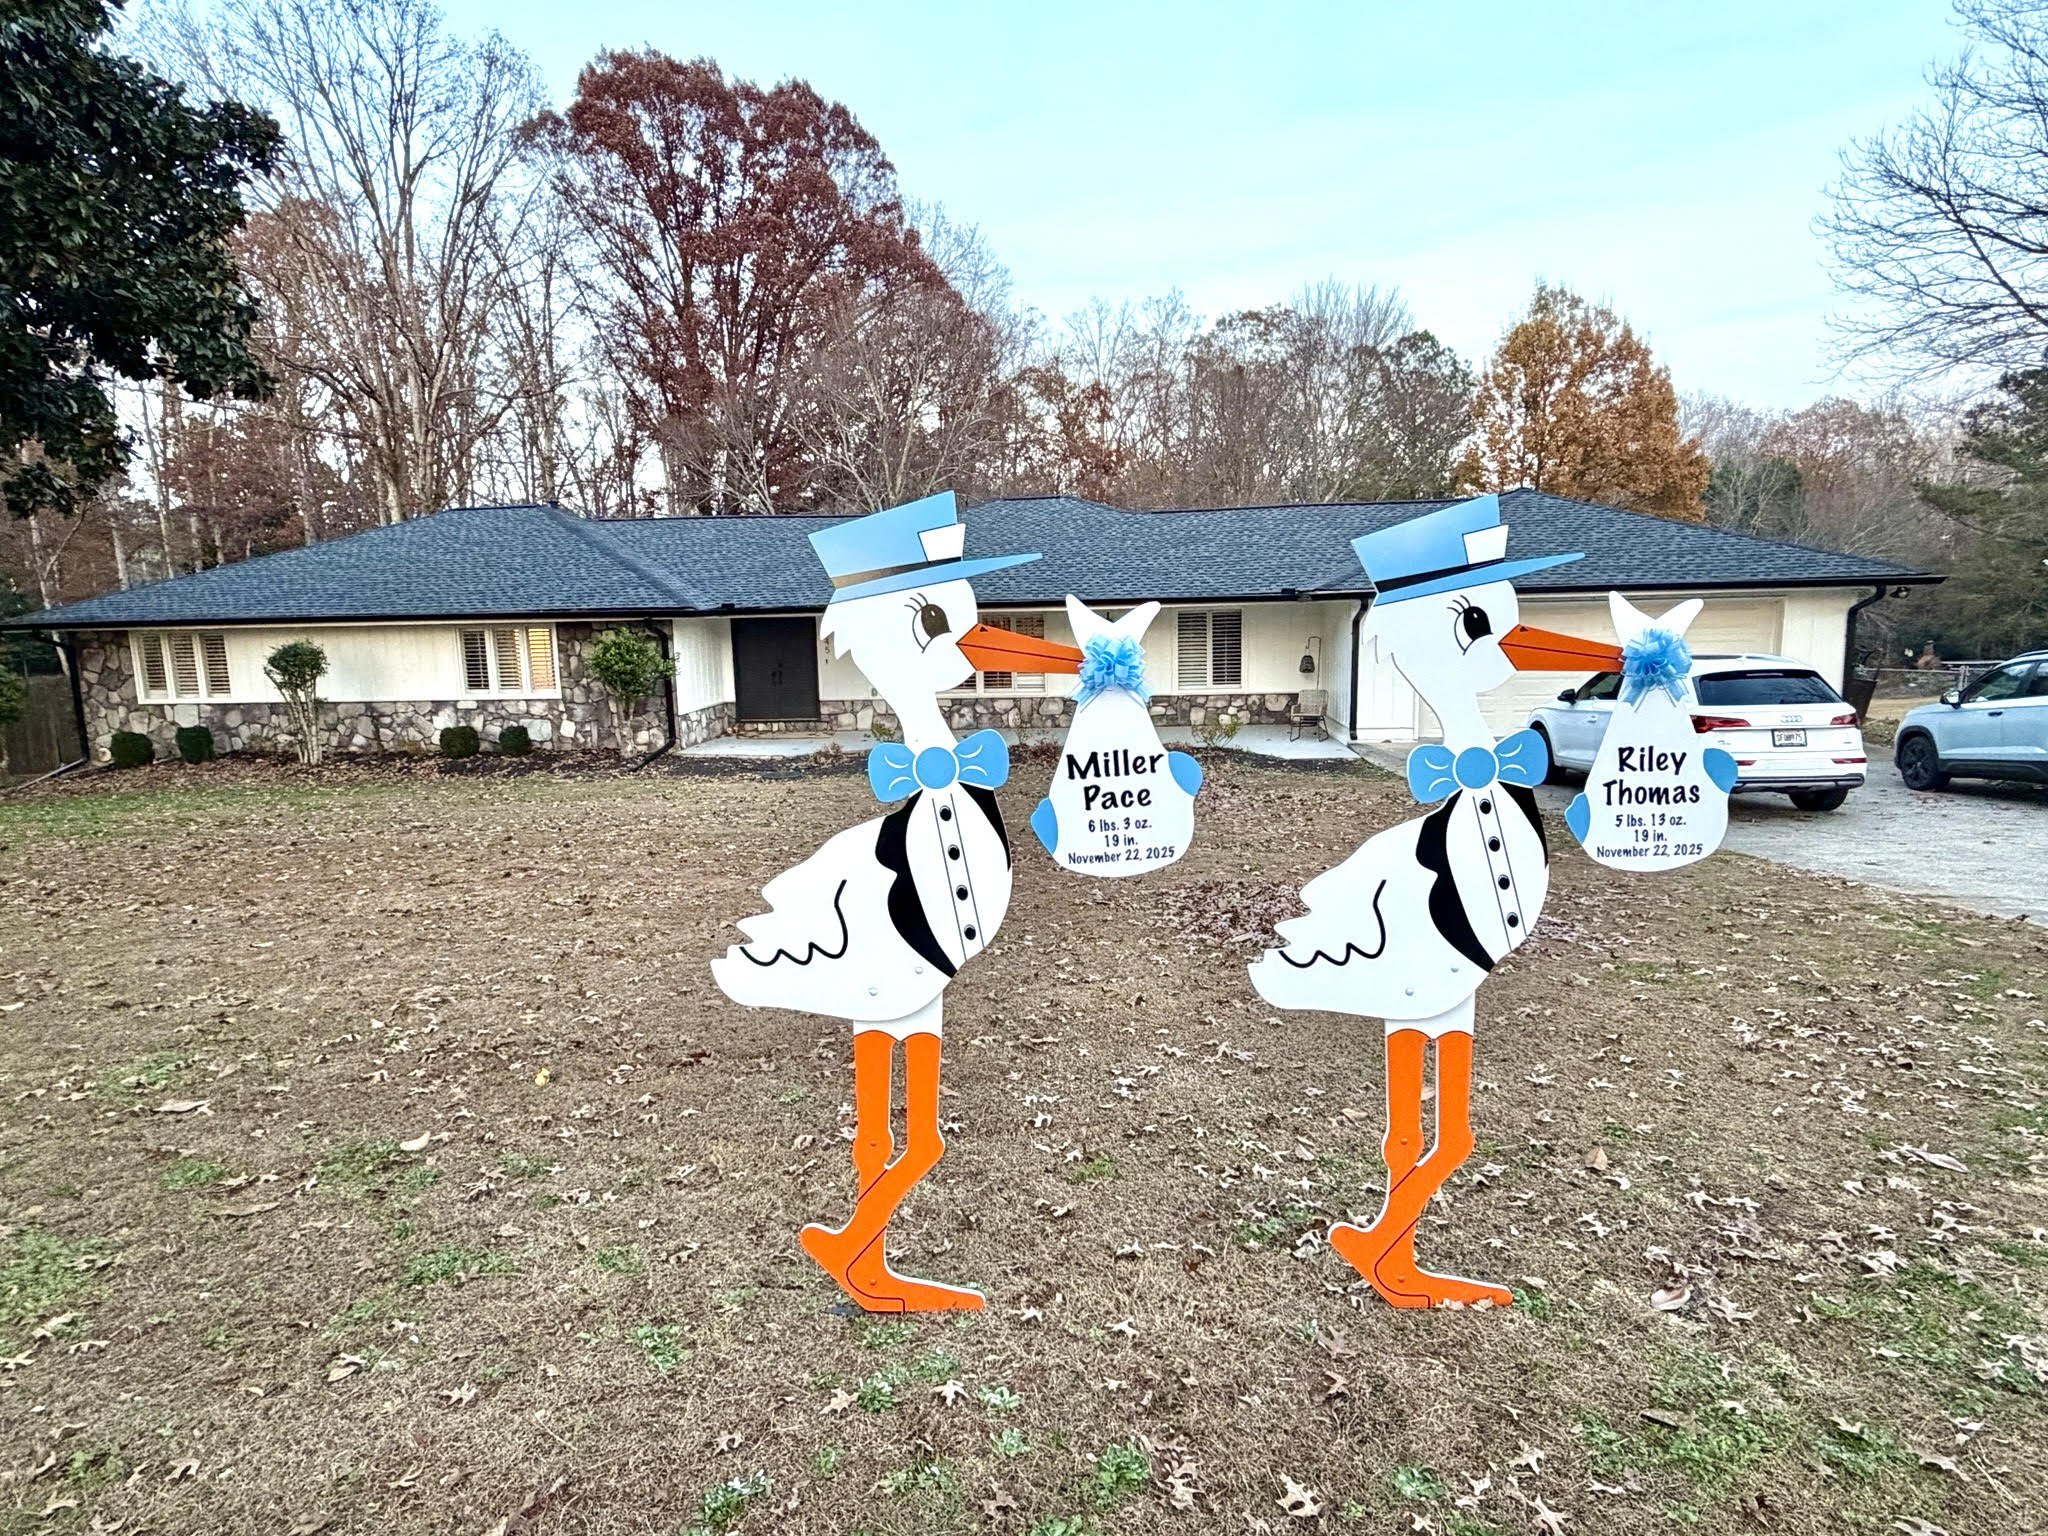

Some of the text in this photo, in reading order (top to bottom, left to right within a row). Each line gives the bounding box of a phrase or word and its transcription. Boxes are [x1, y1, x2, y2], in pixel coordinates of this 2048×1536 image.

[1066, 749, 1164, 780] Miller
[1618, 746, 1687, 776] Riley
[1084, 784, 1152, 811] Pace
[1603, 779, 1700, 806] Thomas
[1088, 817, 1152, 832] 6 lbs. 3 oz.
[1615, 813, 1687, 828] 5 lbs. 13 oz.
[1104, 834, 1138, 847] 19 in.
[1634, 829, 1667, 842] 19 in.
[1068, 846, 1175, 864] November 22, 2025
[1596, 843, 1703, 857] November 22, 2025
